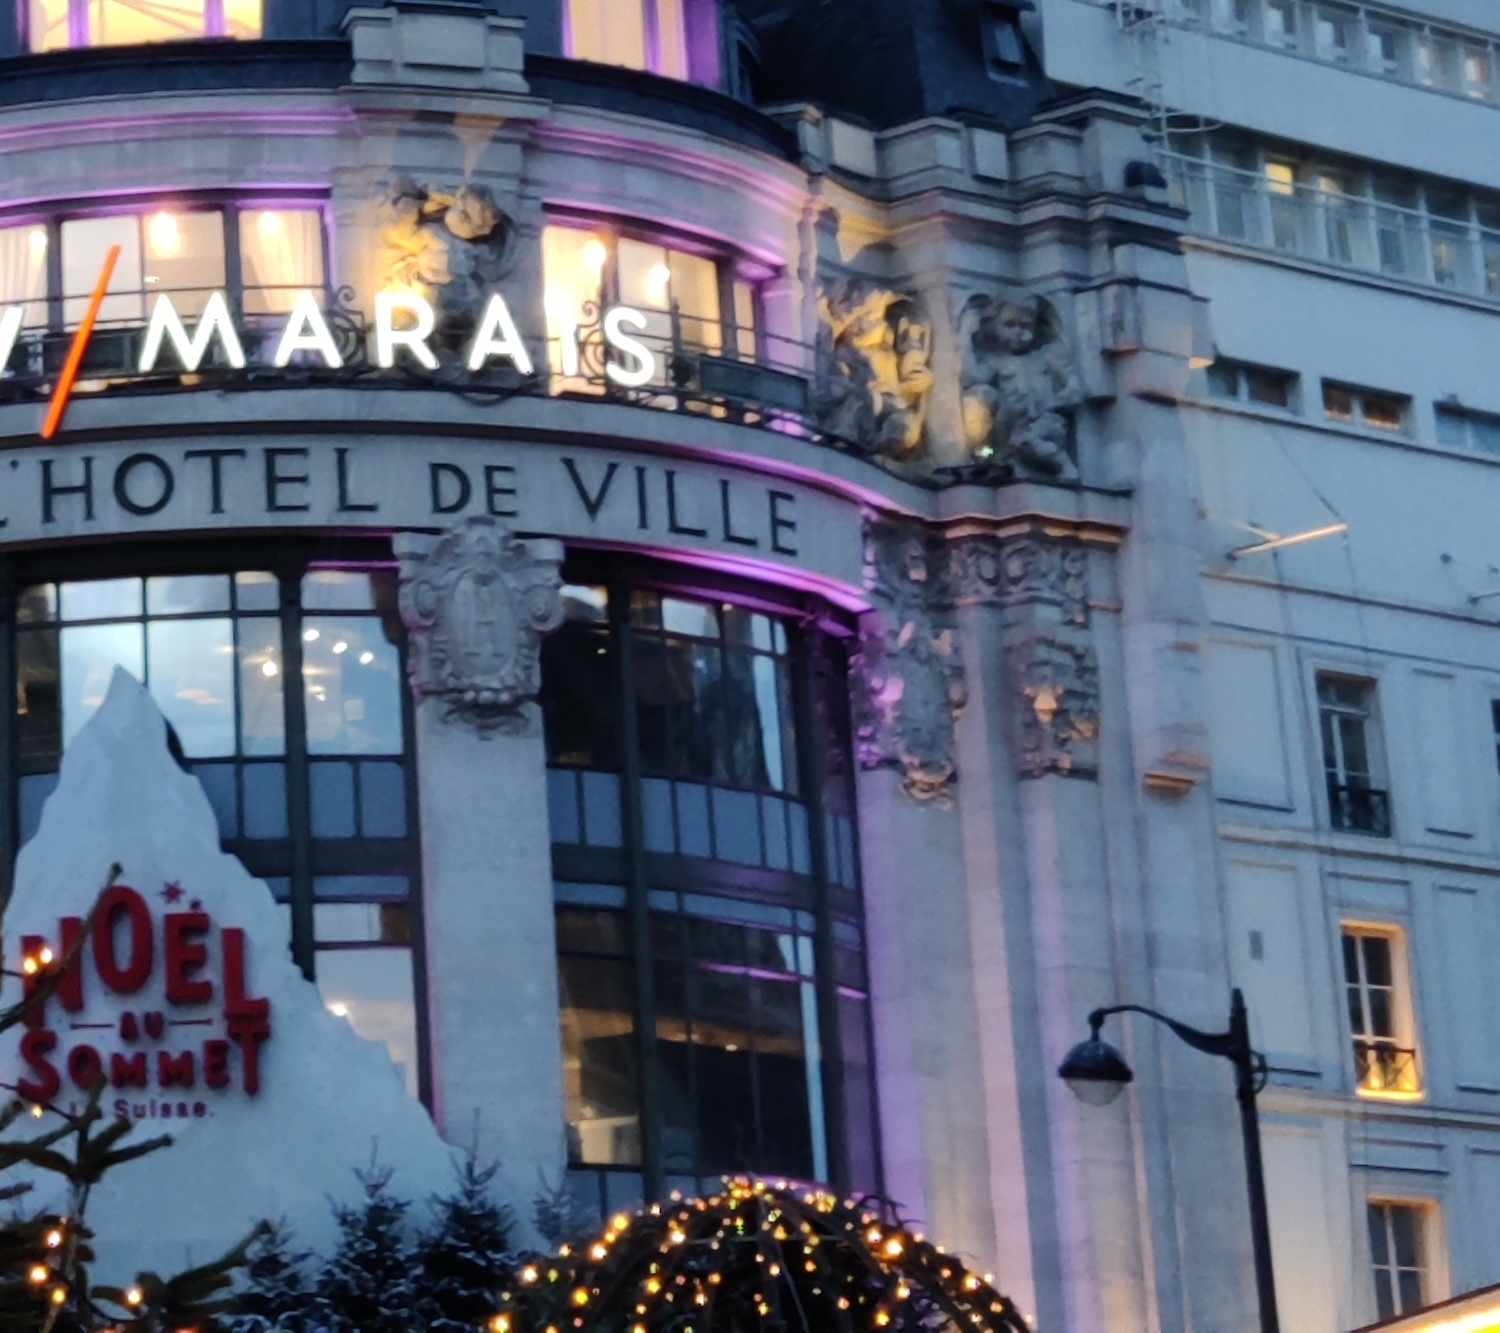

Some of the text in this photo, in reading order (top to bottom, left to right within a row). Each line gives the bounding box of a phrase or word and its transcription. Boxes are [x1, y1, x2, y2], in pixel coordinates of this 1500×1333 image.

[137, 289, 656, 388] MARAIS
[428, 462, 519, 517] DE
[560, 457, 798, 558] VILLE
[16, 1024, 271, 1099] SOMMET
[119, 1010, 164, 1041] AU
